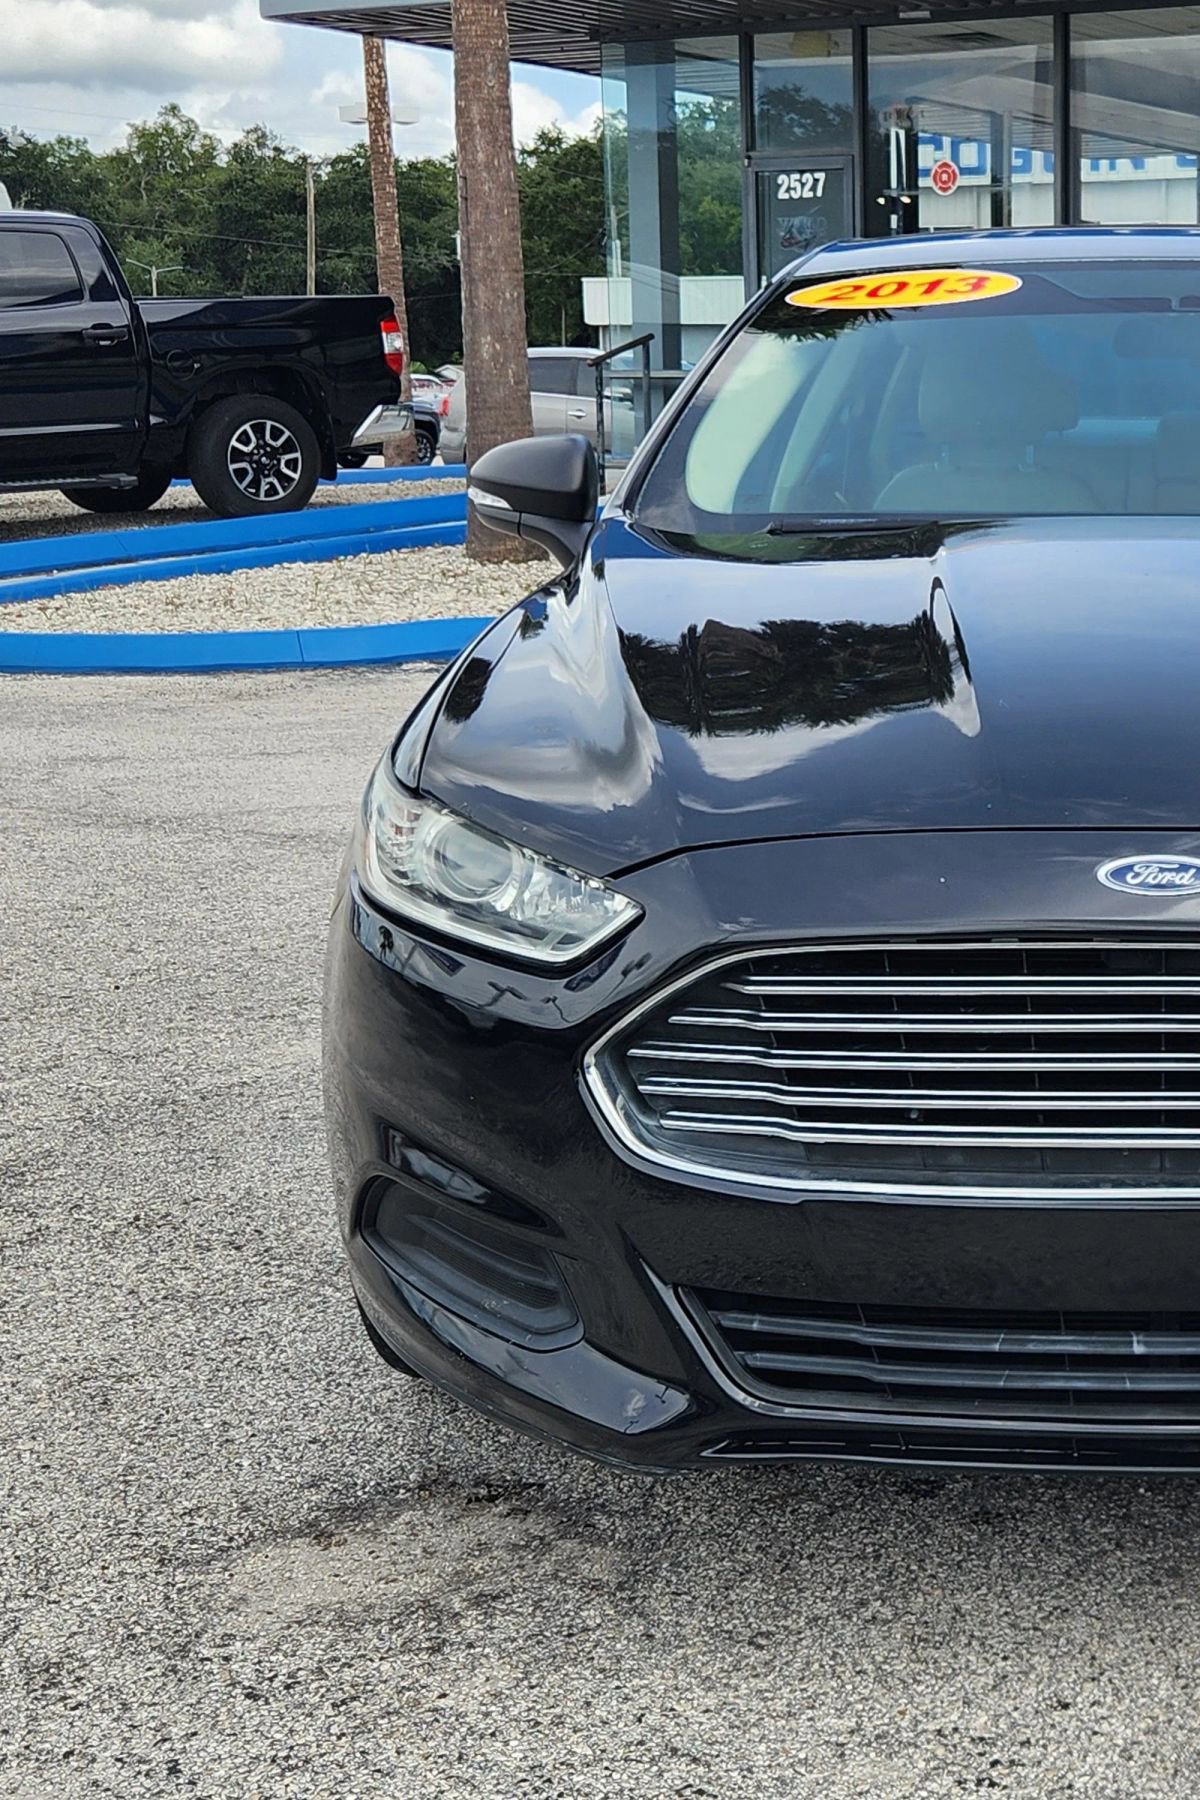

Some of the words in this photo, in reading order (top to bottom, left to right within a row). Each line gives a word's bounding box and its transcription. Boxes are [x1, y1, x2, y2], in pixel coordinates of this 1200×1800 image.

[776, 172, 826, 199] 2527
[815, 276, 991, 303] 2013
[1125, 863, 1198, 885] Ford
